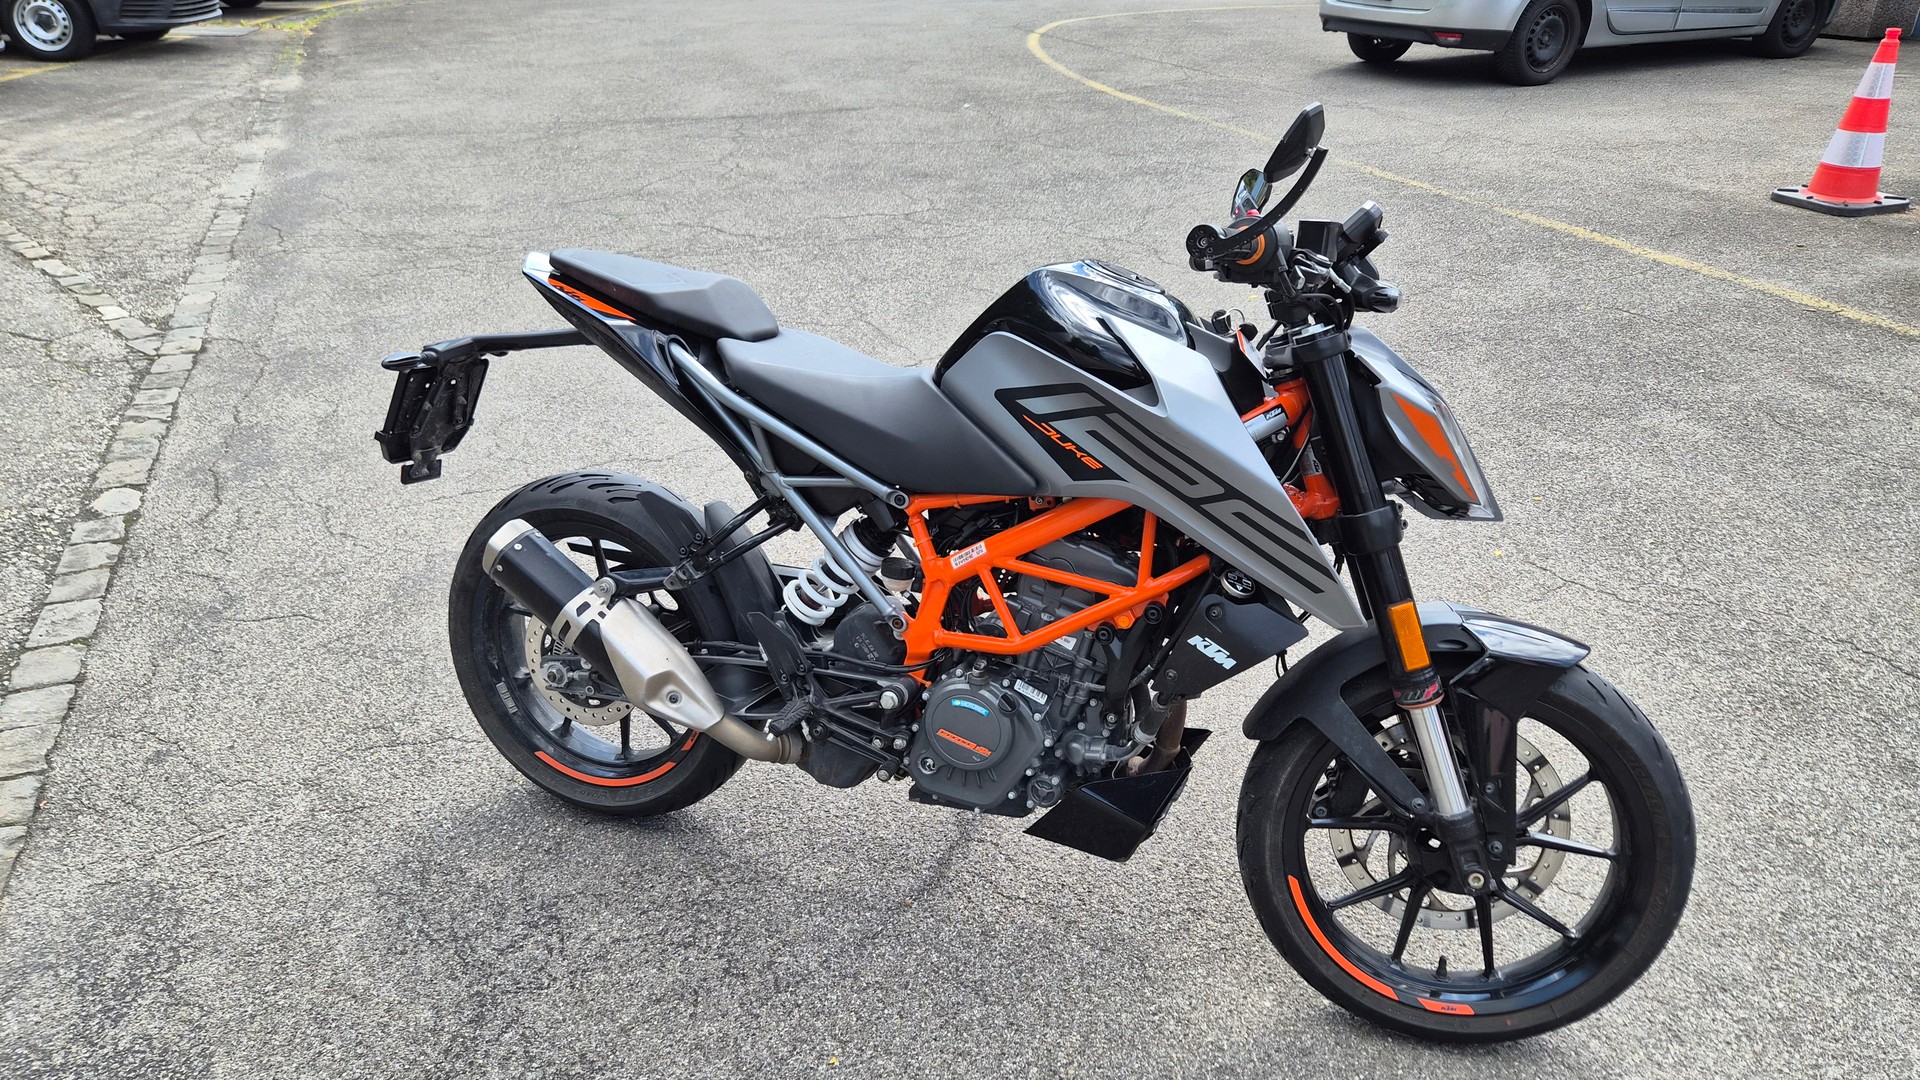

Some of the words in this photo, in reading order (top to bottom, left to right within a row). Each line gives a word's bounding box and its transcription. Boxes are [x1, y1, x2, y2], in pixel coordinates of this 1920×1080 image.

[1265, 407, 1283, 419] KTM
[1022, 413, 1103, 470] DUKE
[1186, 634, 1238, 670] KTM
